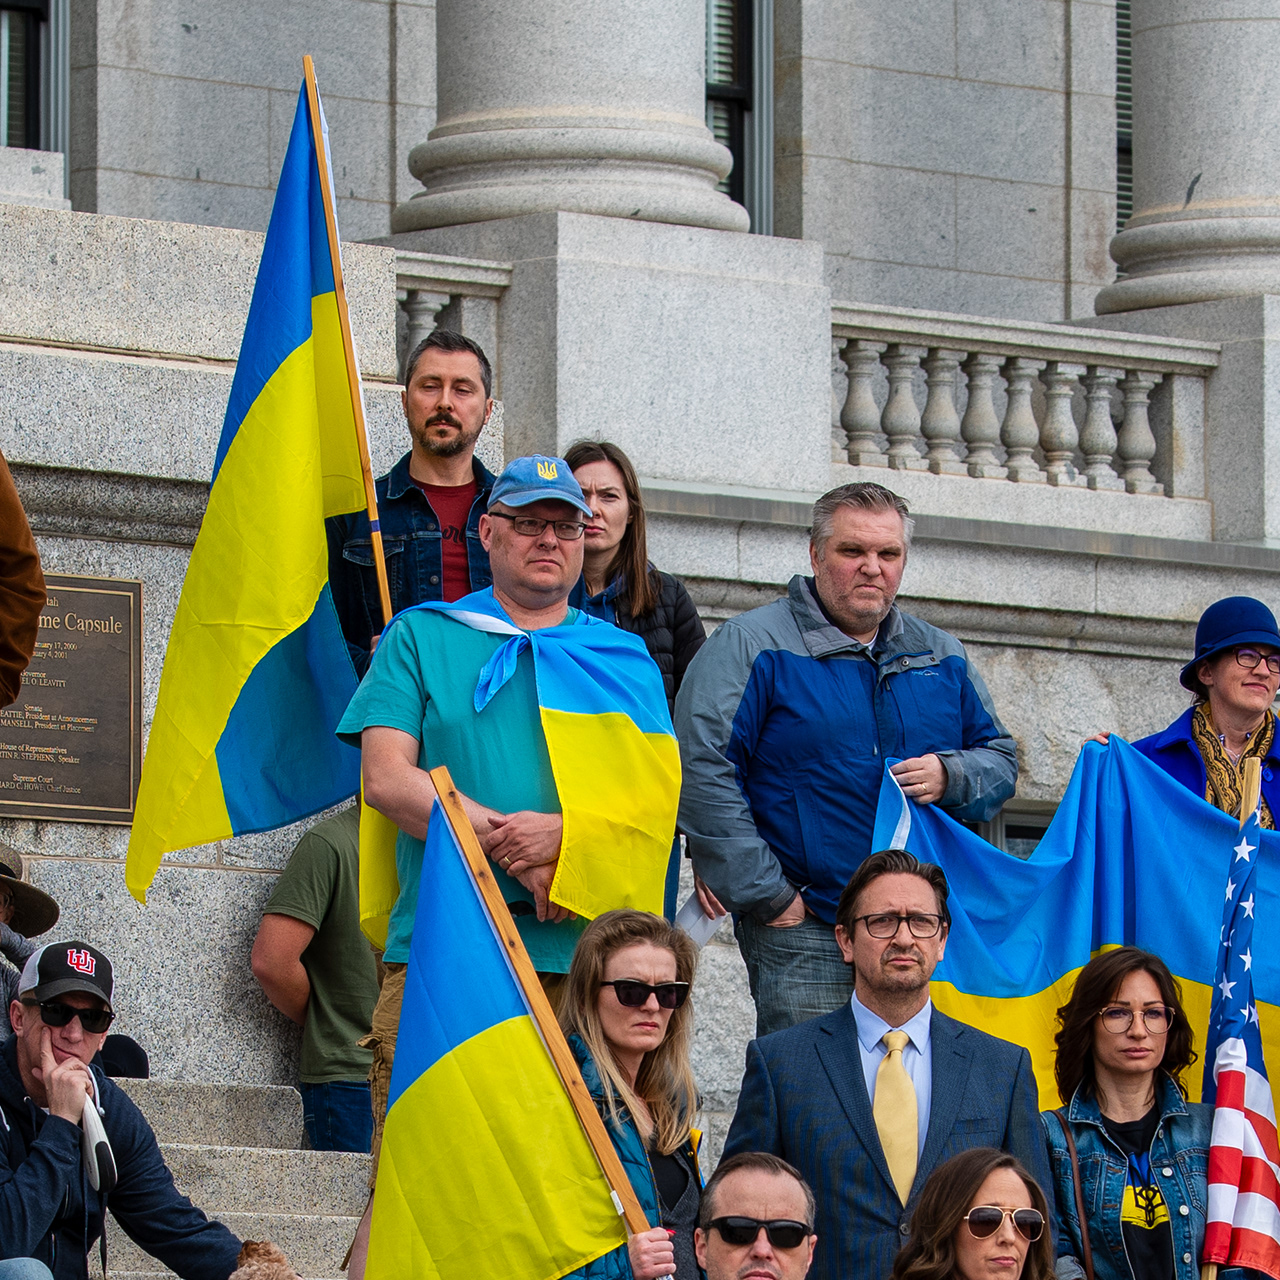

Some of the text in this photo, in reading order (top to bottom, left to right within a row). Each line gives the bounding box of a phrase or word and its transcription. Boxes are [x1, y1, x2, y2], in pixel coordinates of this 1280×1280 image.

[46, 597, 59, 607] tah
[39, 613, 123, 636] me Capsule
[54, 642, 63, 650] 17,
[39, 679, 67, 688] LEAVITT
[0, 719, 34, 729] MANSELL,
[0, 743, 67, 754] House of Representatives
[21, 752, 56, 763] STEPHENS,
[58, 755, 80, 764] Speaker
[12, 773, 53, 783] Supreme Court
[62, 784, 81, 794] Justice
